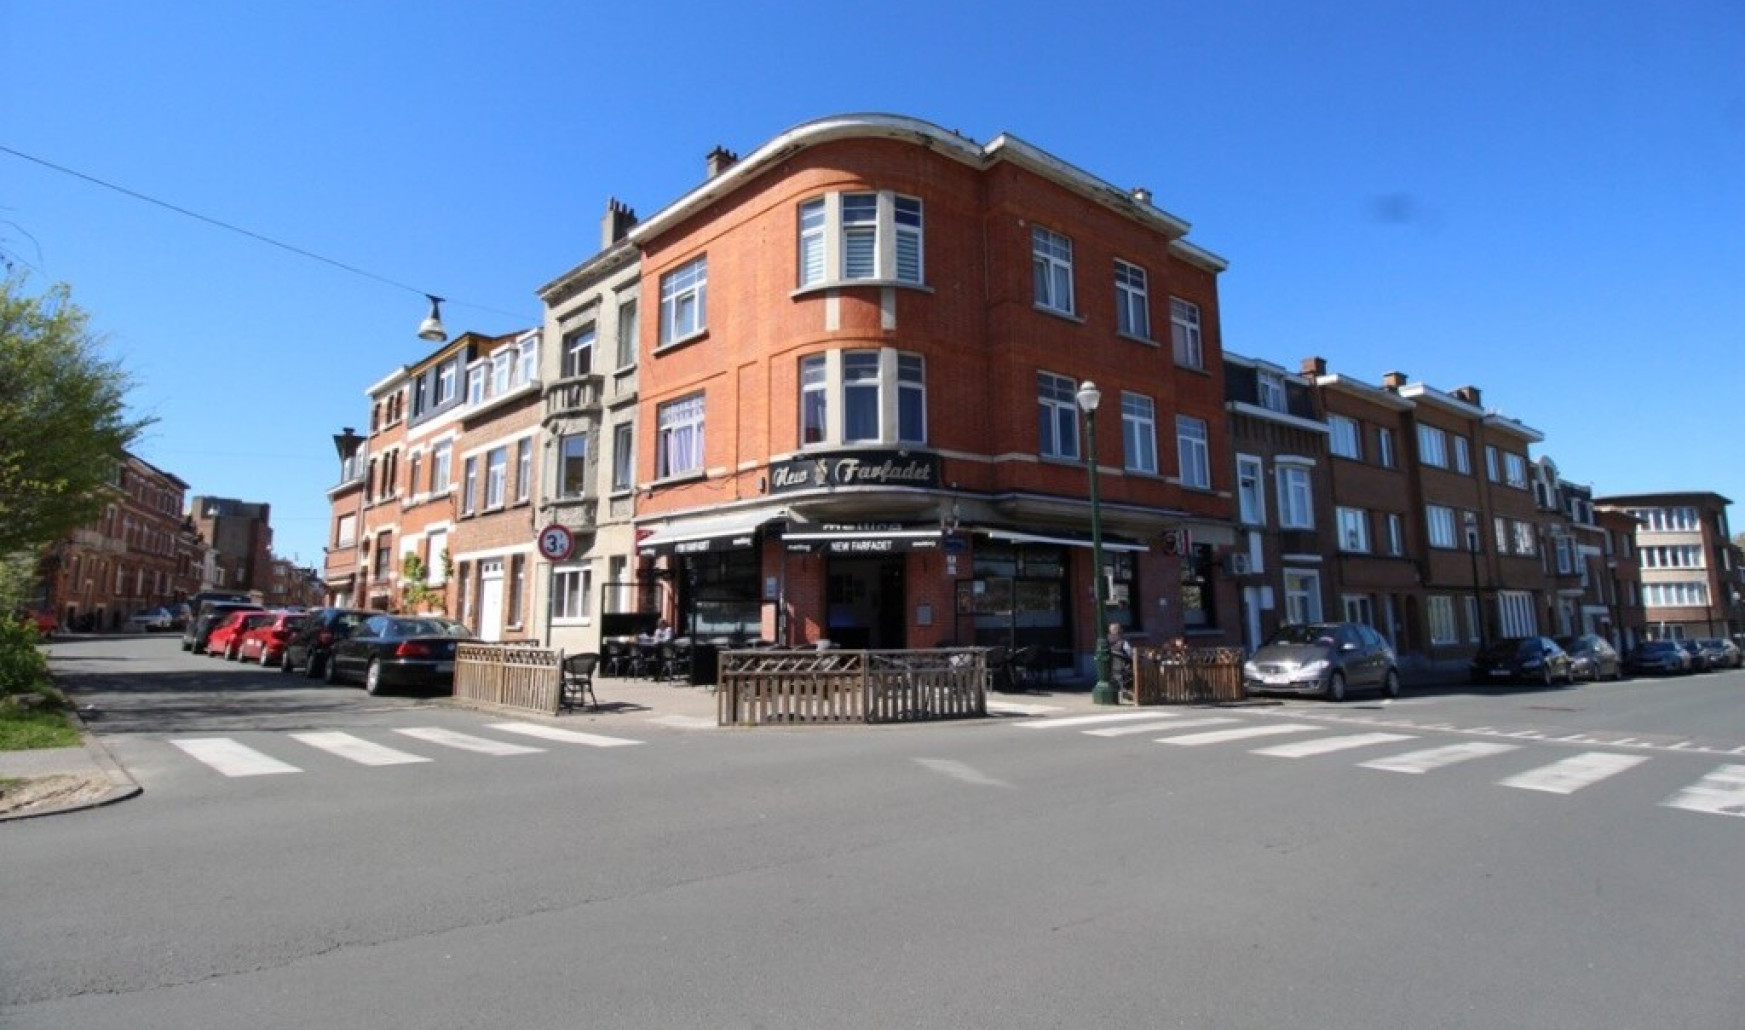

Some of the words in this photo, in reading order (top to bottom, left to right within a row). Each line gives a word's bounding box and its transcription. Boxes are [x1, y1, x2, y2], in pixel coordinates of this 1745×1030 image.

[773, 466, 808, 487] New
[834, 458, 931, 482] Farfadet
[830, 540, 850, 551] NEW
[851, 539, 893, 551] FARFADET
